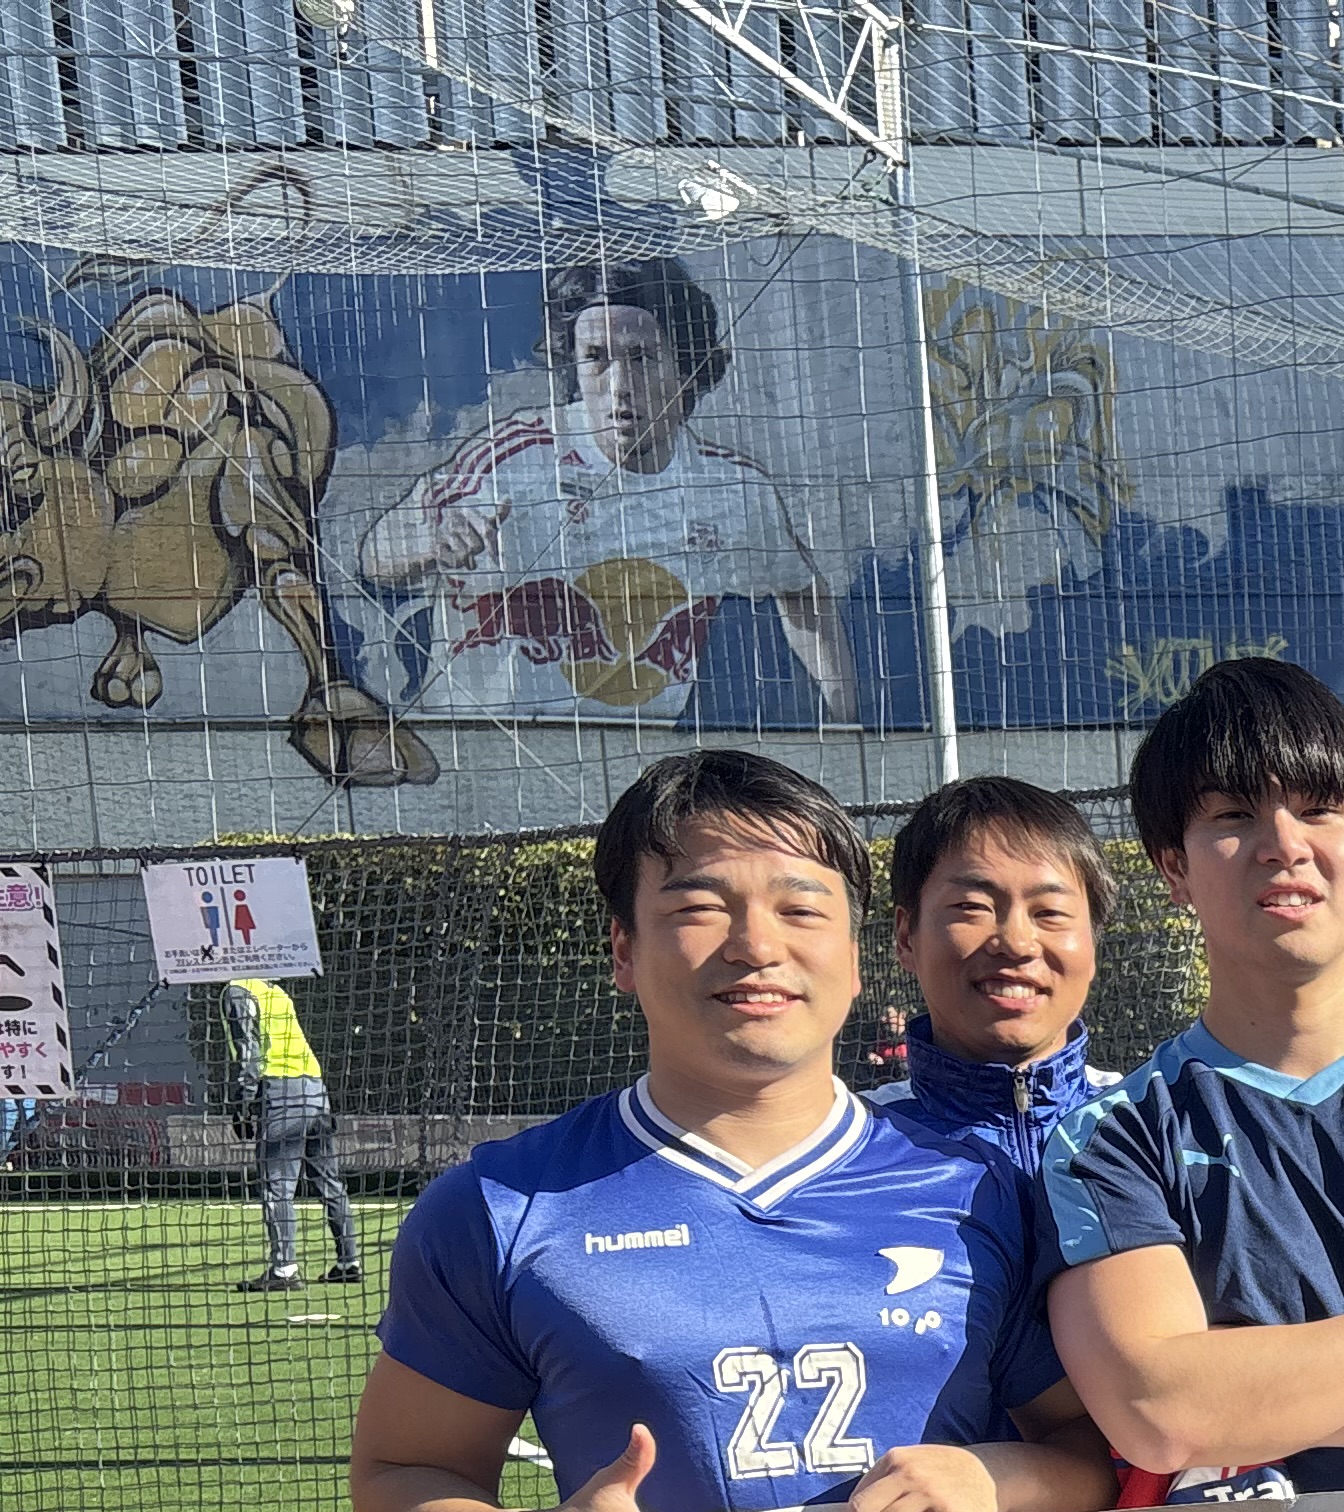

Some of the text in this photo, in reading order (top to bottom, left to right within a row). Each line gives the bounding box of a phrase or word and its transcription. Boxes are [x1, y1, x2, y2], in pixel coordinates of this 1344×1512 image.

[183, 863, 256, 887] TOILET
[585, 1223, 690, 1255] hummel
[712, 1341, 875, 1480] 22
